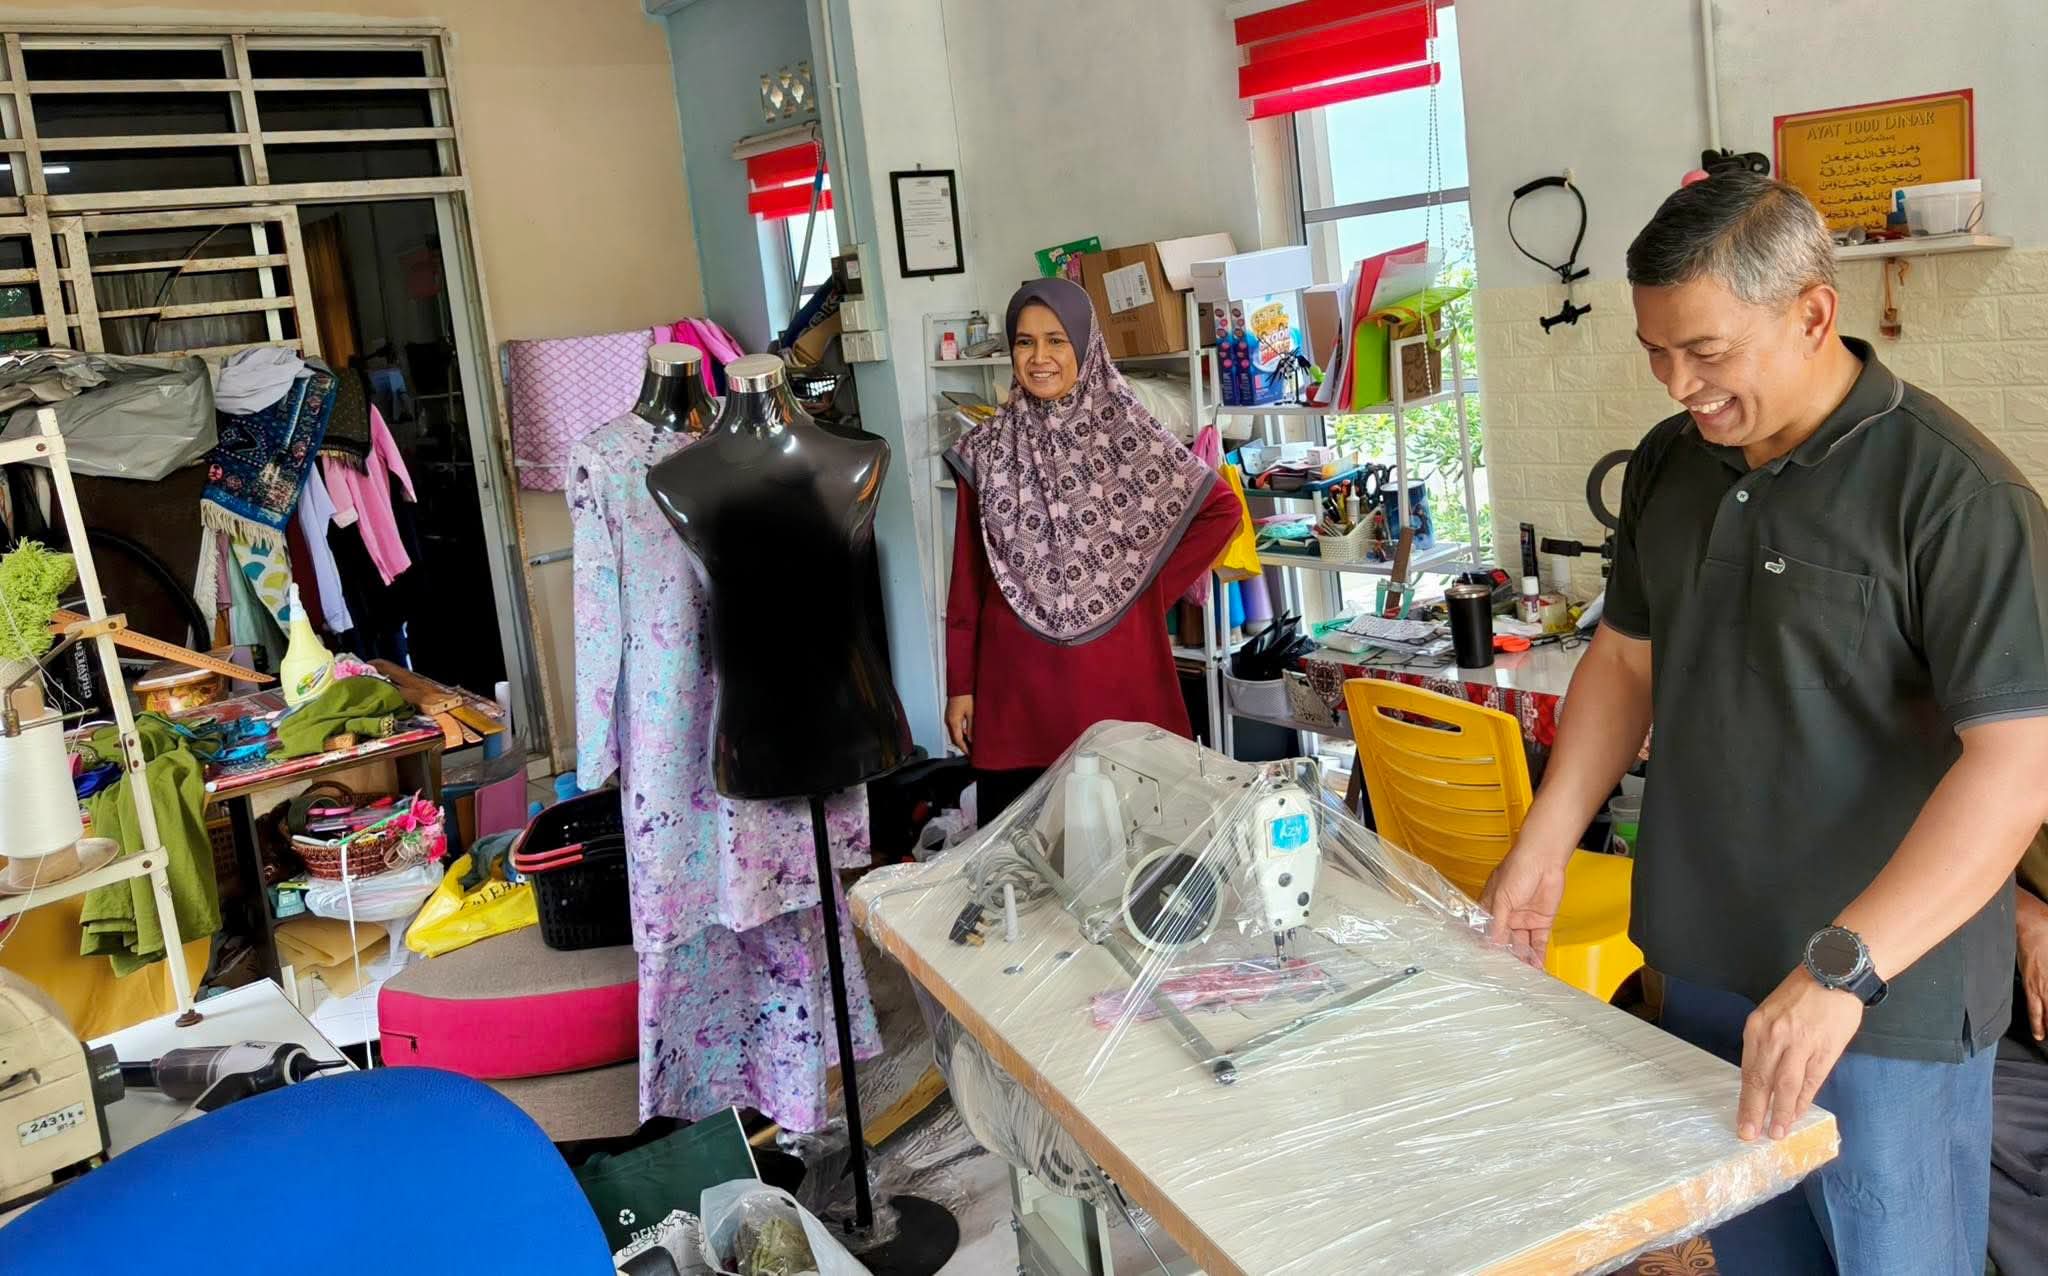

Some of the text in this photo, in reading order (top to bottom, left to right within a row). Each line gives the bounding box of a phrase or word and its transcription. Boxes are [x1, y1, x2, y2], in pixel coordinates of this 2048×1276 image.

[1807, 123, 1842, 141] AYAT
[1847, 119, 1880, 135] 1000
[1885, 111, 1936, 130] DINAR
[73, 641, 93, 699] CRAWLER
